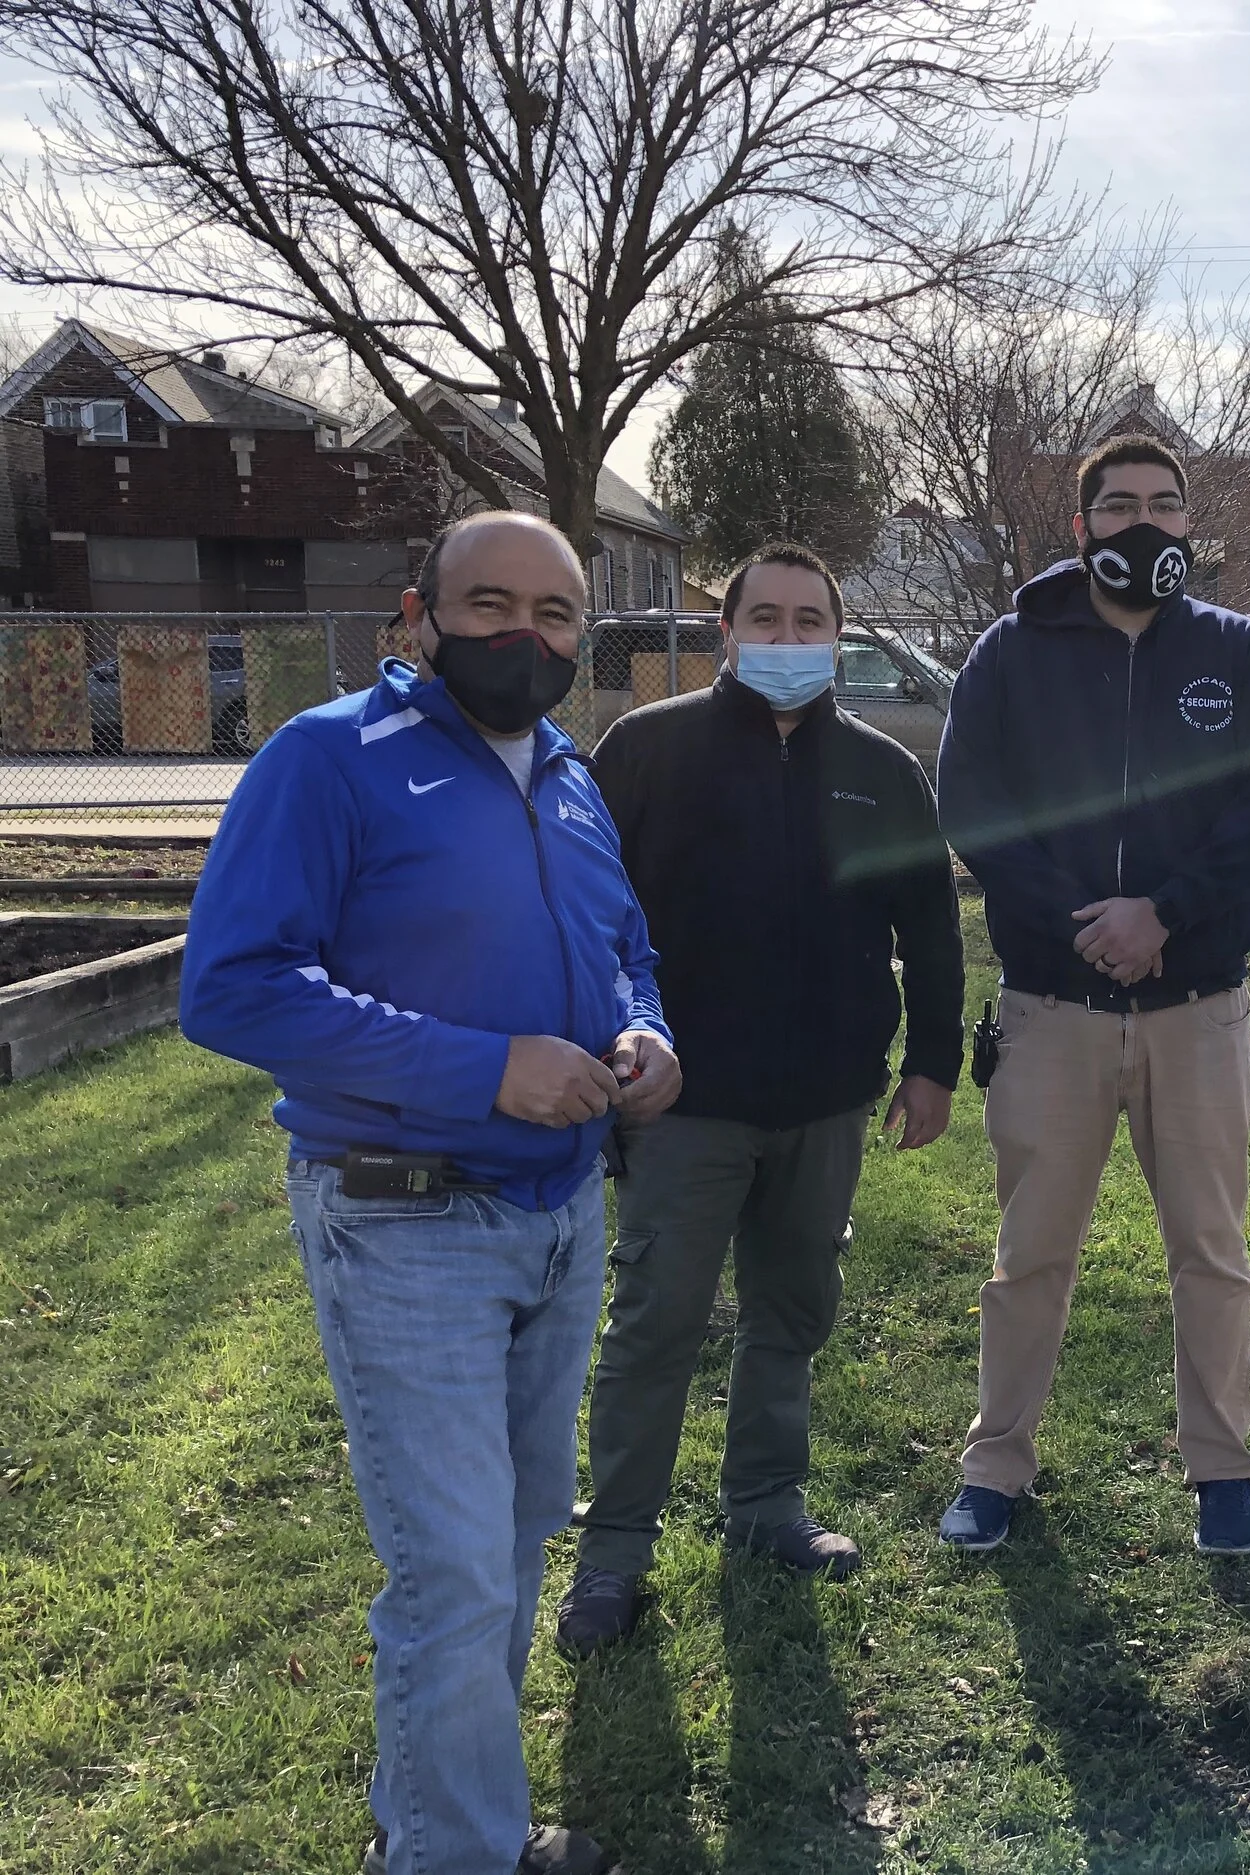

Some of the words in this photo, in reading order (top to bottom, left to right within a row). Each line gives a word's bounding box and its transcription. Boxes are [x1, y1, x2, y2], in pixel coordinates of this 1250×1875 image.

[1182, 677, 1232, 695] CHICAGO
[1186, 697, 1228, 709] SECURITY
[1179, 706, 1201, 729] PUBLIC
